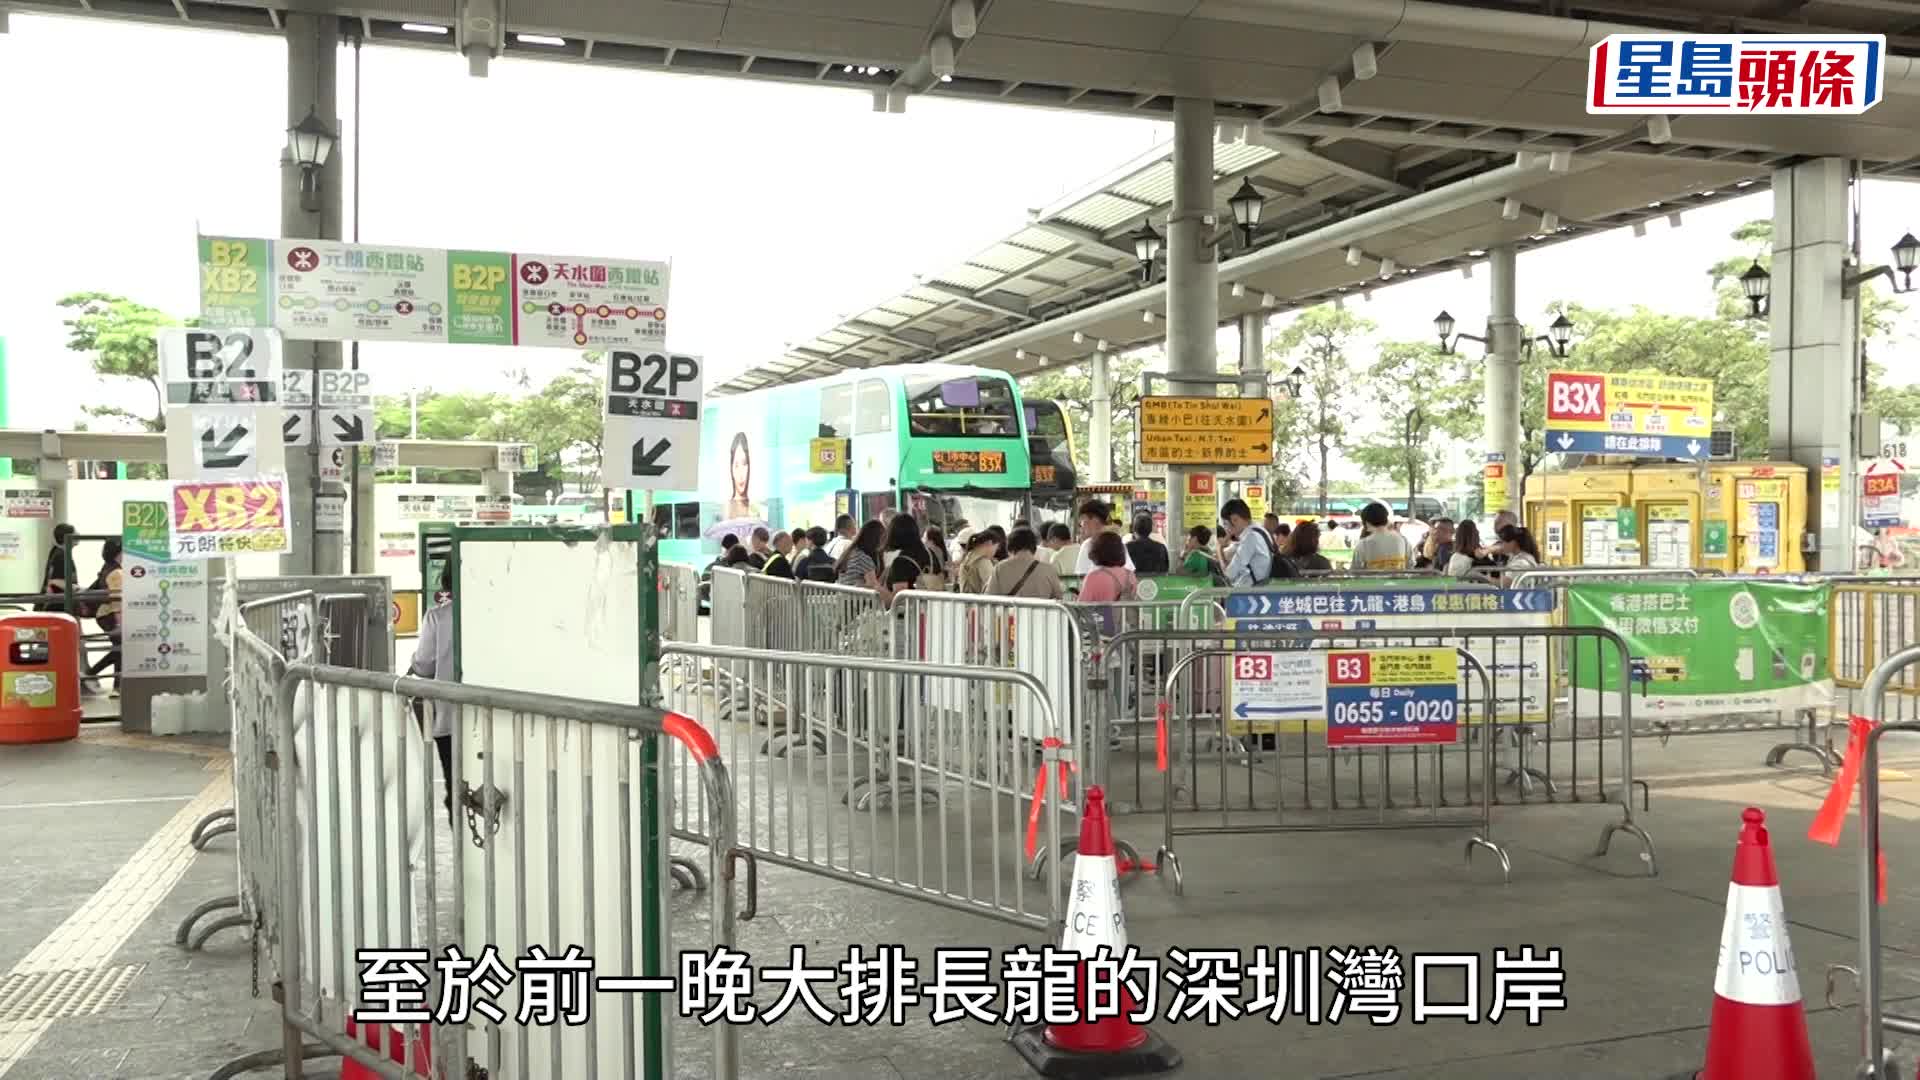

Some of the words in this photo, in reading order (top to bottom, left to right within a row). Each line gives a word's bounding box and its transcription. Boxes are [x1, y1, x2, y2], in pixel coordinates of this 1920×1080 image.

[210, 241, 248, 267] B2
[203, 267, 257, 293] XB2
[453, 264, 505, 291] B2P
[186, 333, 256, 379] B2
[322, 372, 370, 393] B2P
[611, 351, 699, 396] B2P
[1552, 381, 1601, 414] B3X
[979, 452, 1004, 472] B3X
[1866, 477, 1898, 493] B3A
[177, 485, 280, 531] XB2
[1278, 595, 1346, 614] 坐城巴往
[1240, 657, 1267, 678] B3
[1336, 658, 1361, 680] B3
[1369, 687, 1391, 698] 每日
[1393, 688, 1415, 698] Daily
[1334, 701, 1384, 724] 0655
[1404, 699, 1453, 722] 0020
